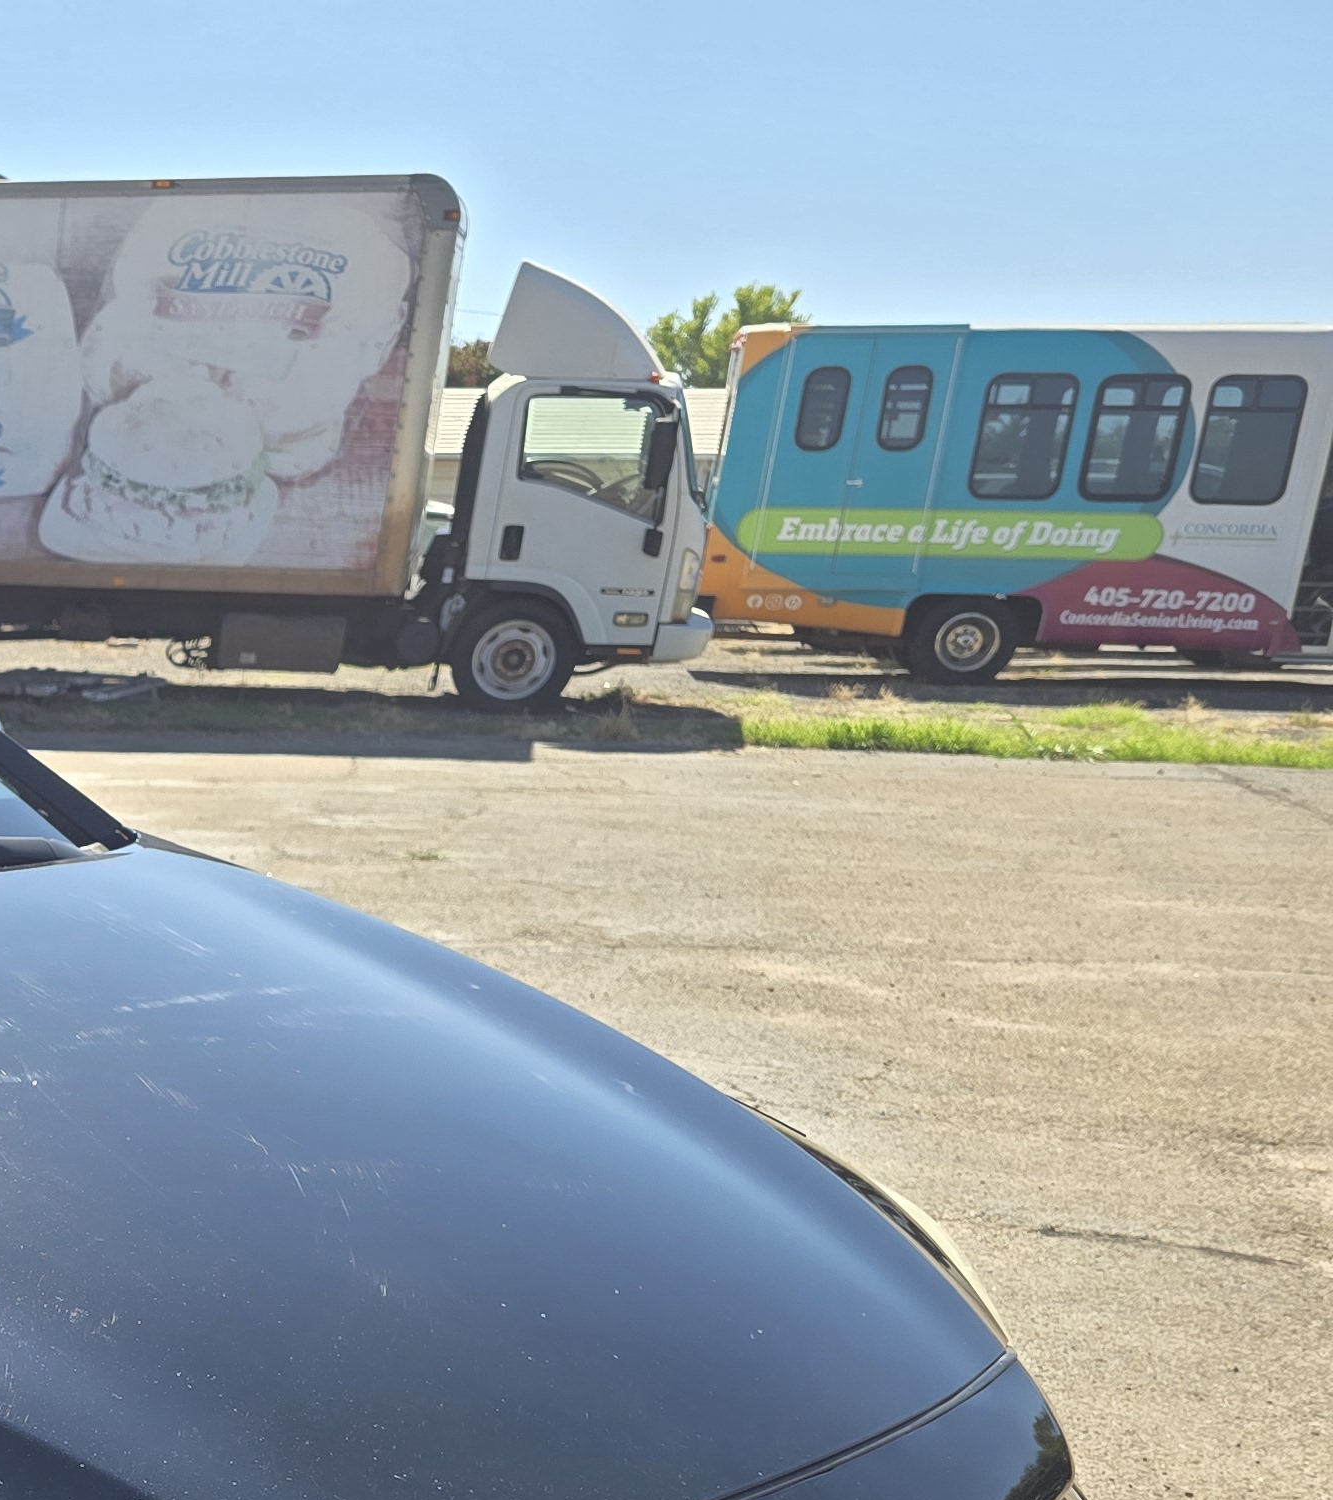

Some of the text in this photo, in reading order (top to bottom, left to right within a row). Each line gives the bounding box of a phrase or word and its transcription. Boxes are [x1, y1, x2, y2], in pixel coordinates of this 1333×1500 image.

[167, 231, 346, 273] Cobblestone
[179, 261, 255, 291] Mill
[777, 517, 1121, 554] Embrace a Life of Doing
[1184, 522, 1277, 536] CONCORDIA
[1084, 586, 1256, 613] 405-720-7200
[1059, 610, 1259, 632] ConcordiaSeniorLiving.com
